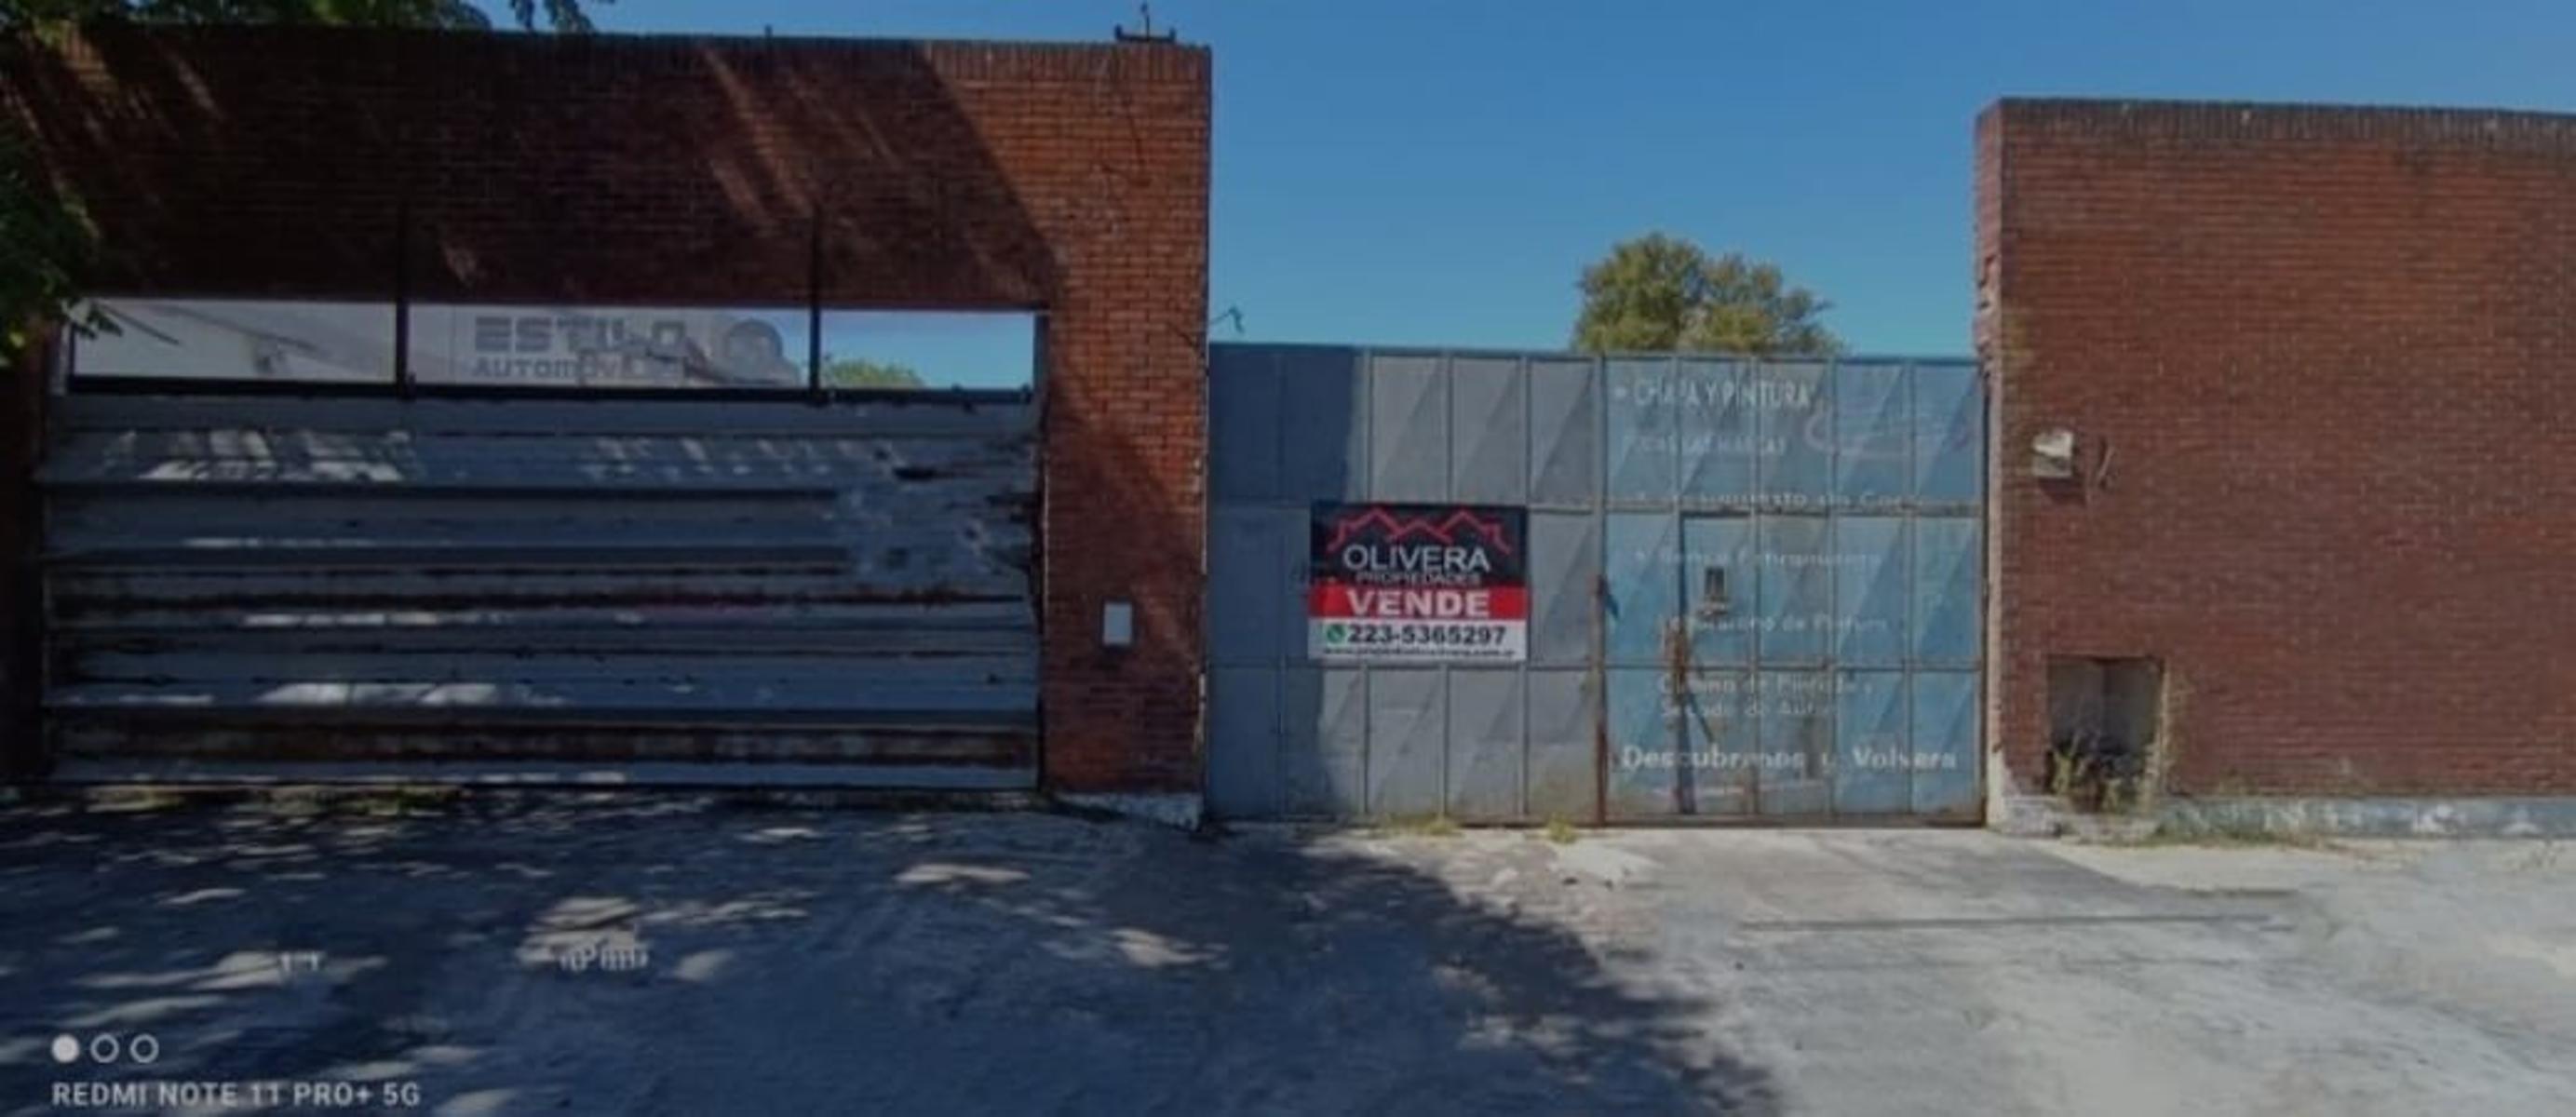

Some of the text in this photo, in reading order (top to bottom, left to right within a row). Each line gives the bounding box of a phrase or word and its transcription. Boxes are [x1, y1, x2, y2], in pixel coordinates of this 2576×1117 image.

[475, 315, 686, 357] ESTILO
[1342, 544, 1491, 572] OLIVERA
[1347, 590, 1491, 616] VENDE
[1347, 625, 1507, 646] 223-5365297
